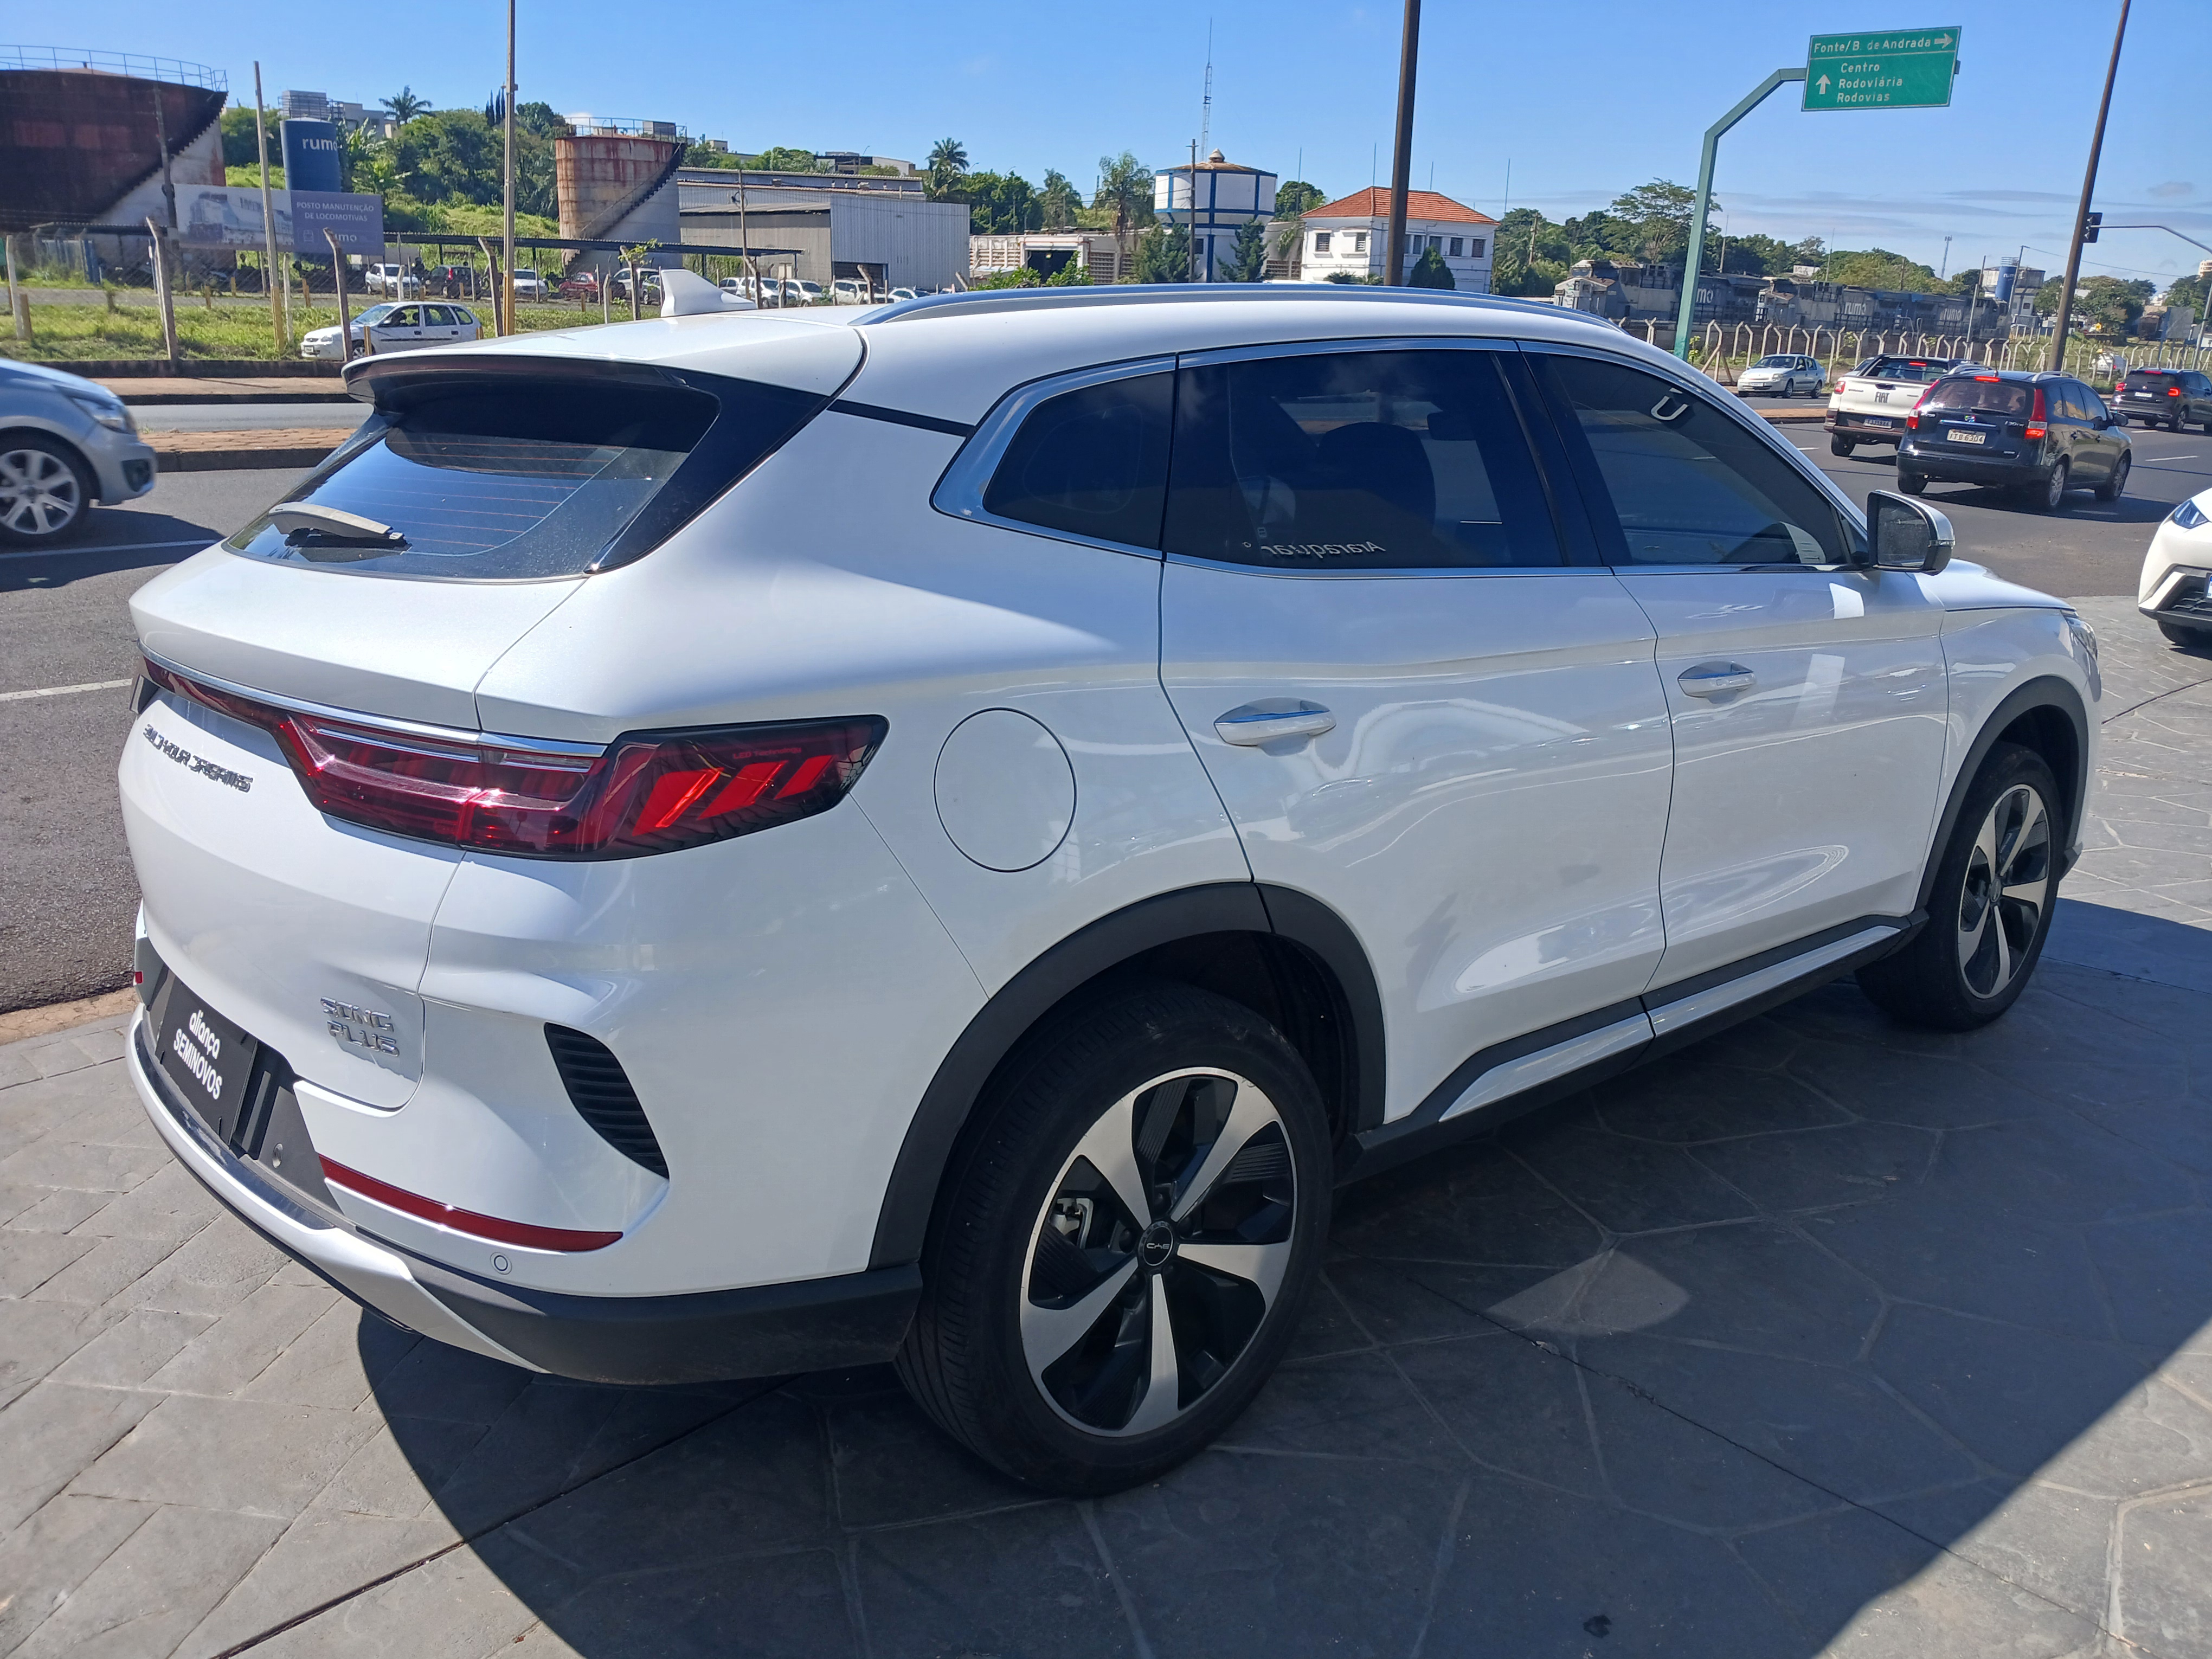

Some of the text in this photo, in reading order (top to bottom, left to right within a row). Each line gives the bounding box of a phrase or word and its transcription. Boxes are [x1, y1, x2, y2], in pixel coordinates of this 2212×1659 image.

[1867, 40, 1880, 50] de
[1882, 37, 1931, 49] Andrada
[1841, 62, 1880, 73] Centro
[1838, 75, 1903, 88] Rodoviária
[1836, 92, 1890, 102] Rodovias
[297, 202, 374, 213] POSTO MANUTENÇÃO
[316, 213, 368, 222] LOCOMOTIVAS
[1875, 391, 1890, 403] FIAT
[754, 747, 802, 756] Technology
[320, 996, 394, 1033] SONG
[189, 1009, 220, 1059] aliança
[326, 1020, 400, 1057] PLUS
[173, 1028, 222, 1100] SEMINOVOS
